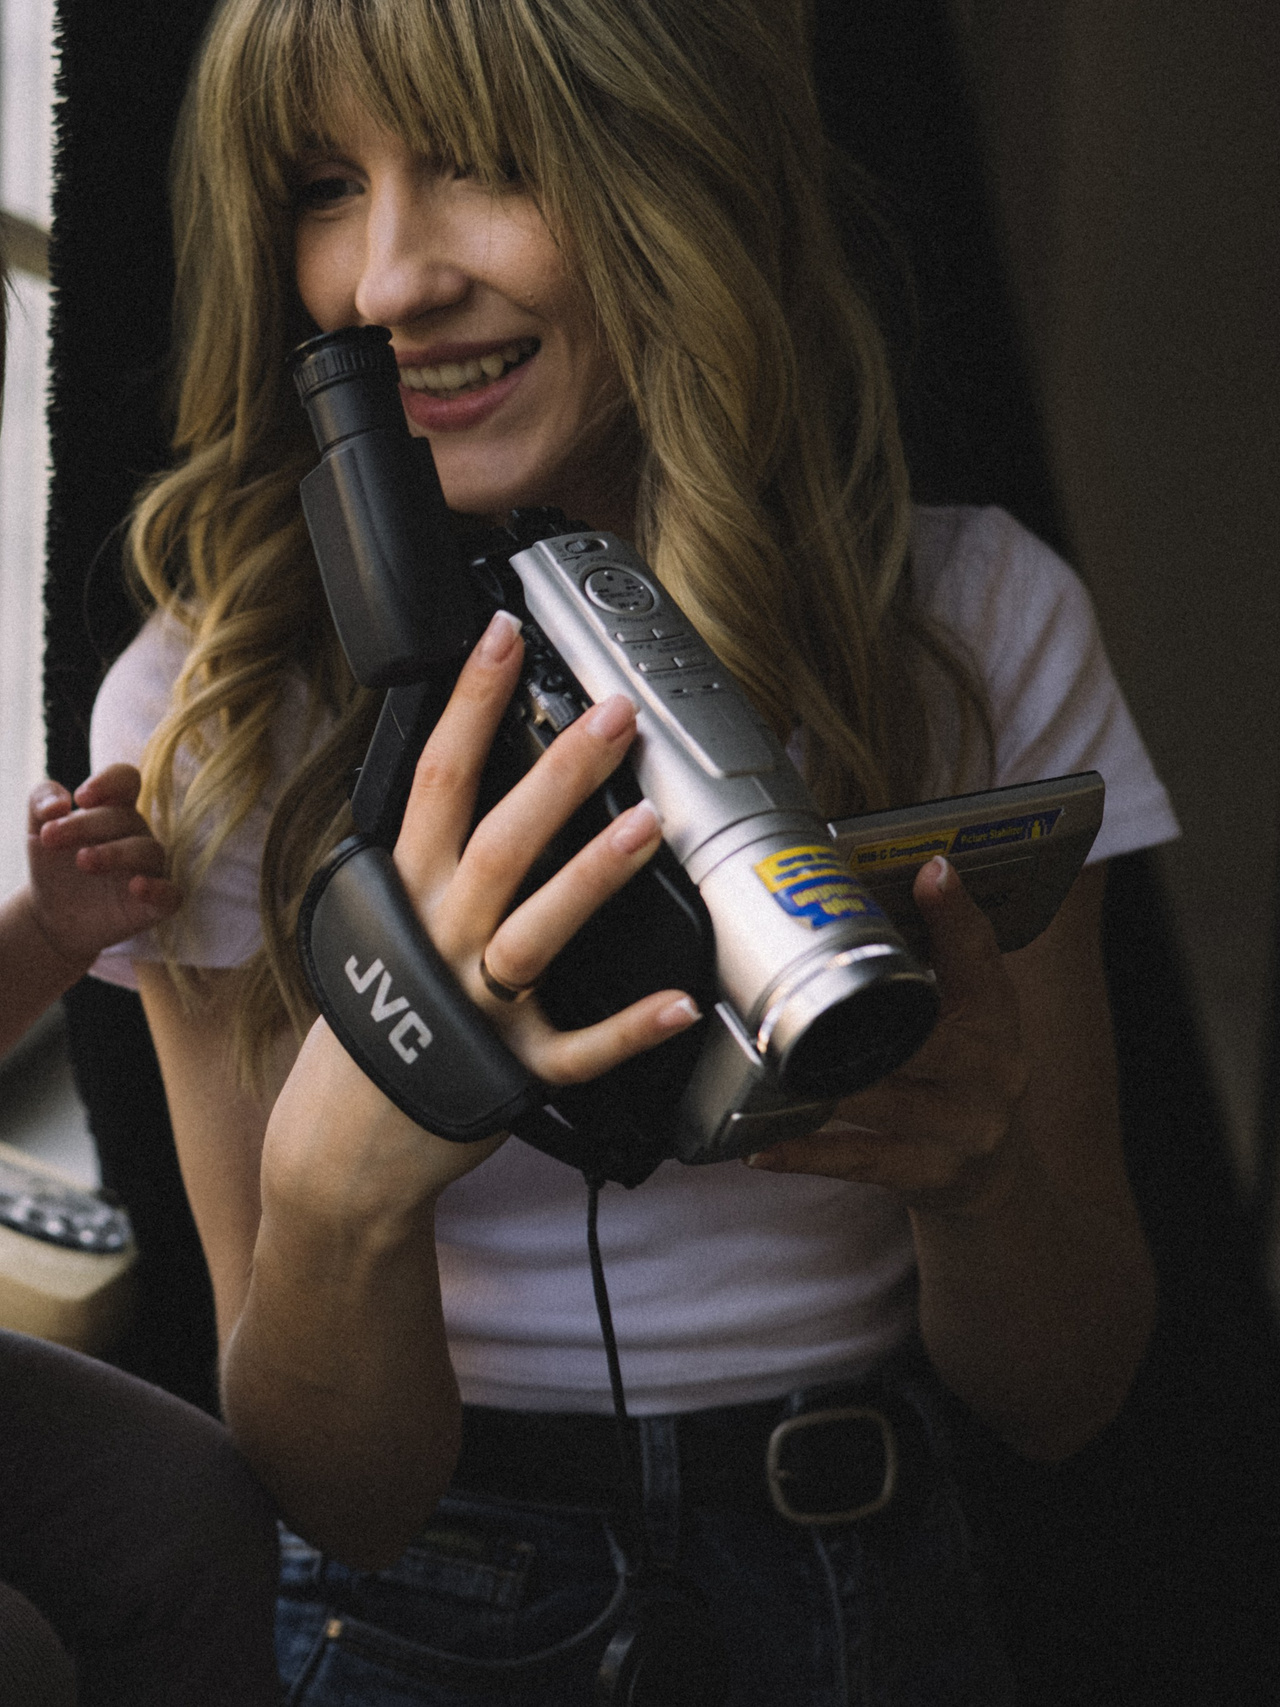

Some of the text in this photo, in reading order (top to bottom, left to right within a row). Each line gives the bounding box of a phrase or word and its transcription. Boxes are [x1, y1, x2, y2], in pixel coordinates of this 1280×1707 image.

[961, 831, 988, 844] Picture
[857, 848, 887, 864] VHS-C
[889, 839, 948, 859] Compatibility
[344, 954, 433, 1065] JVC
